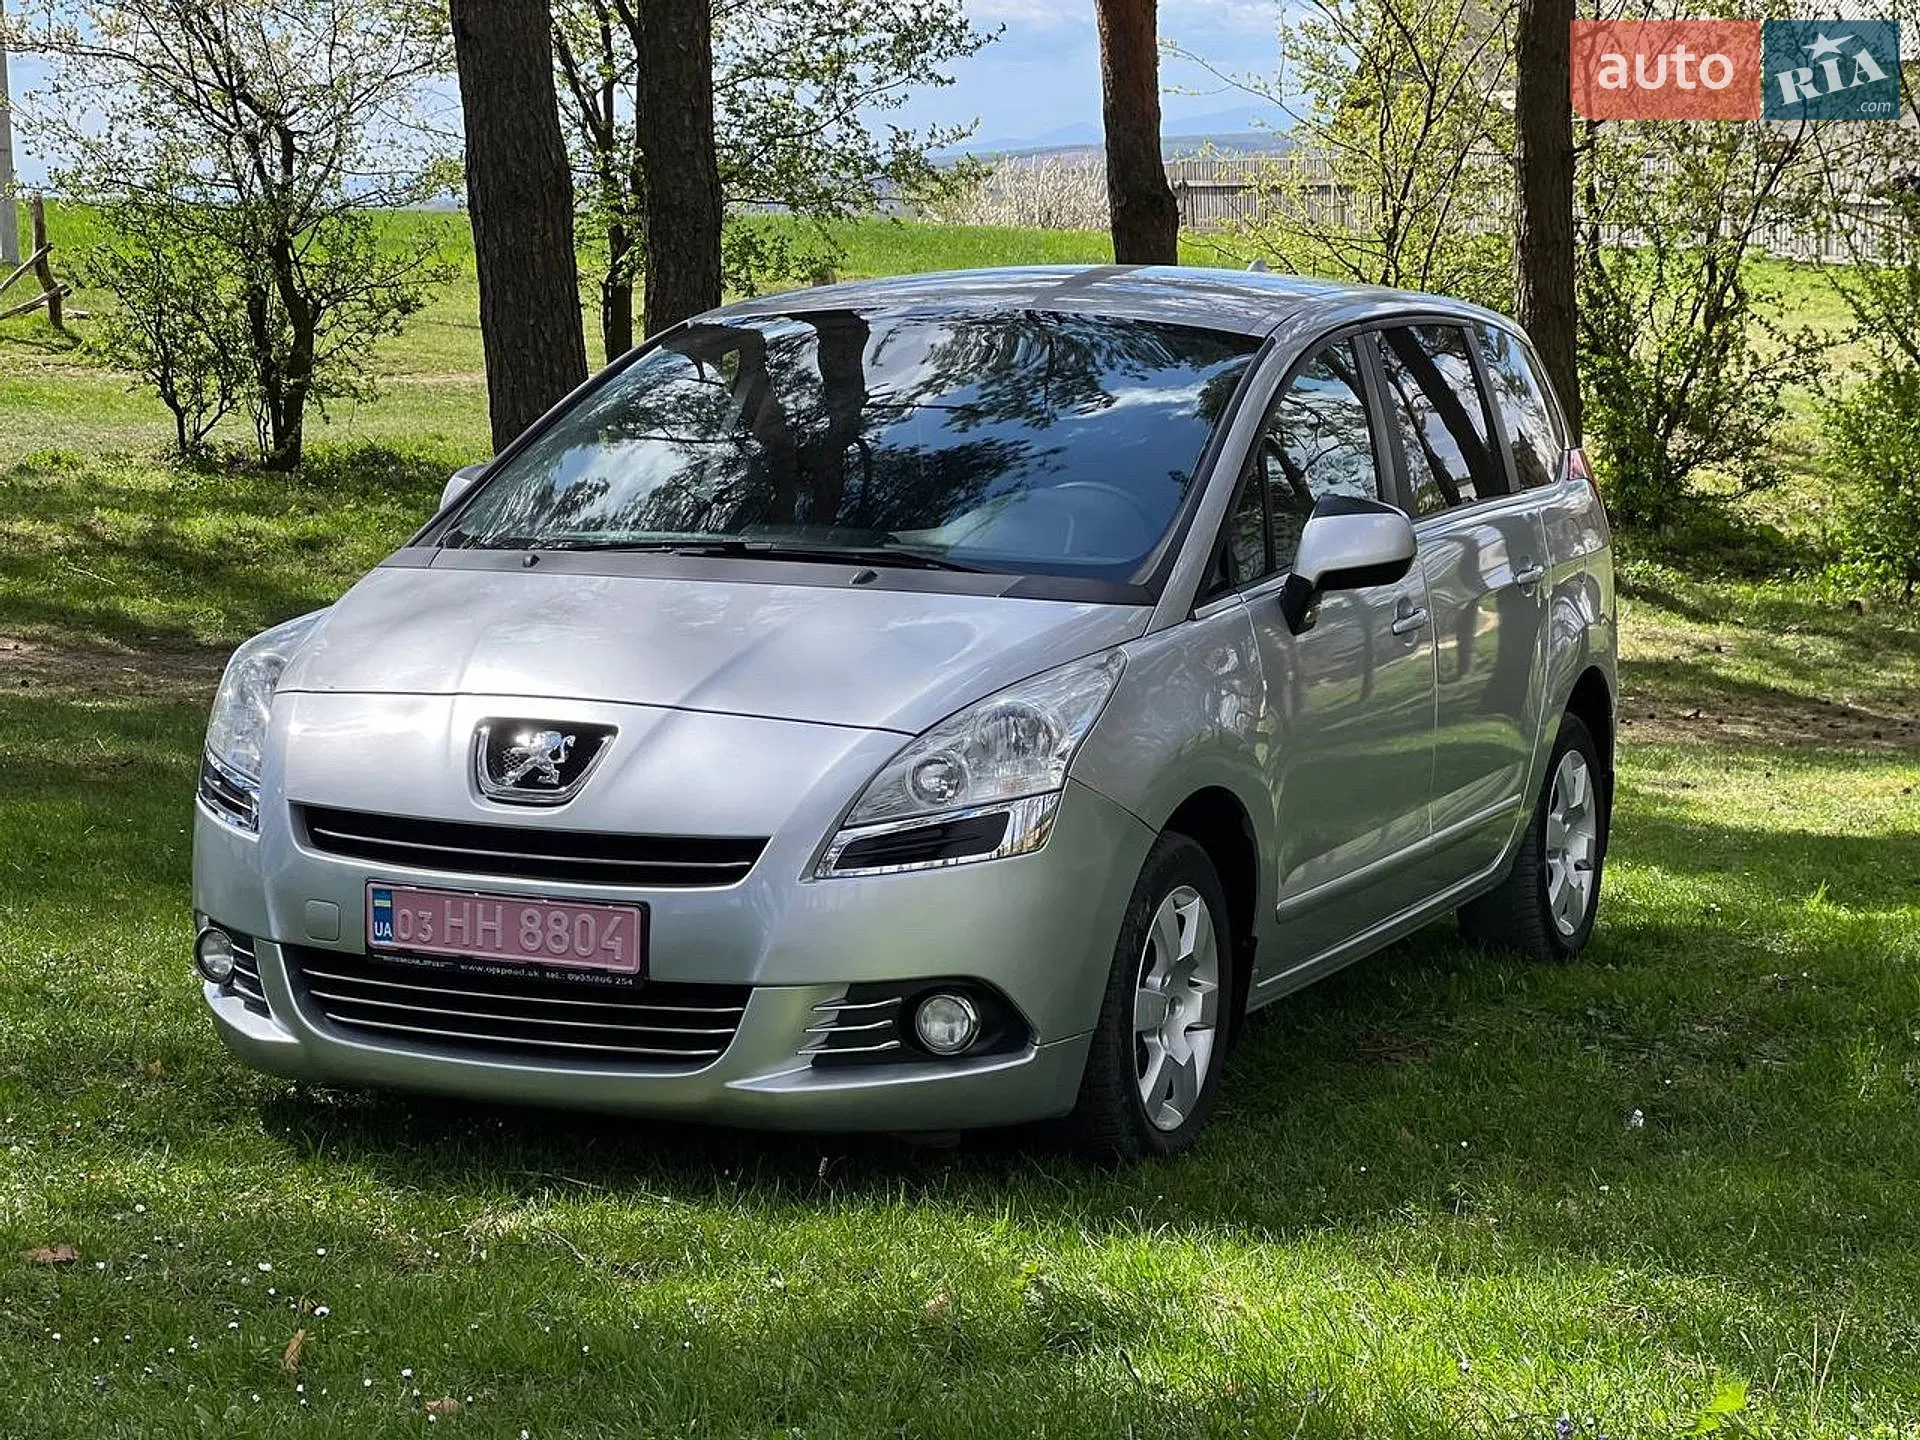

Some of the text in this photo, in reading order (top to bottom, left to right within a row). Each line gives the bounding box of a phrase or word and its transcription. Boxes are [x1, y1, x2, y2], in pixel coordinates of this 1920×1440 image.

[374, 921, 393, 938] UA
[395, 899, 624, 962] 03 HH 8804
